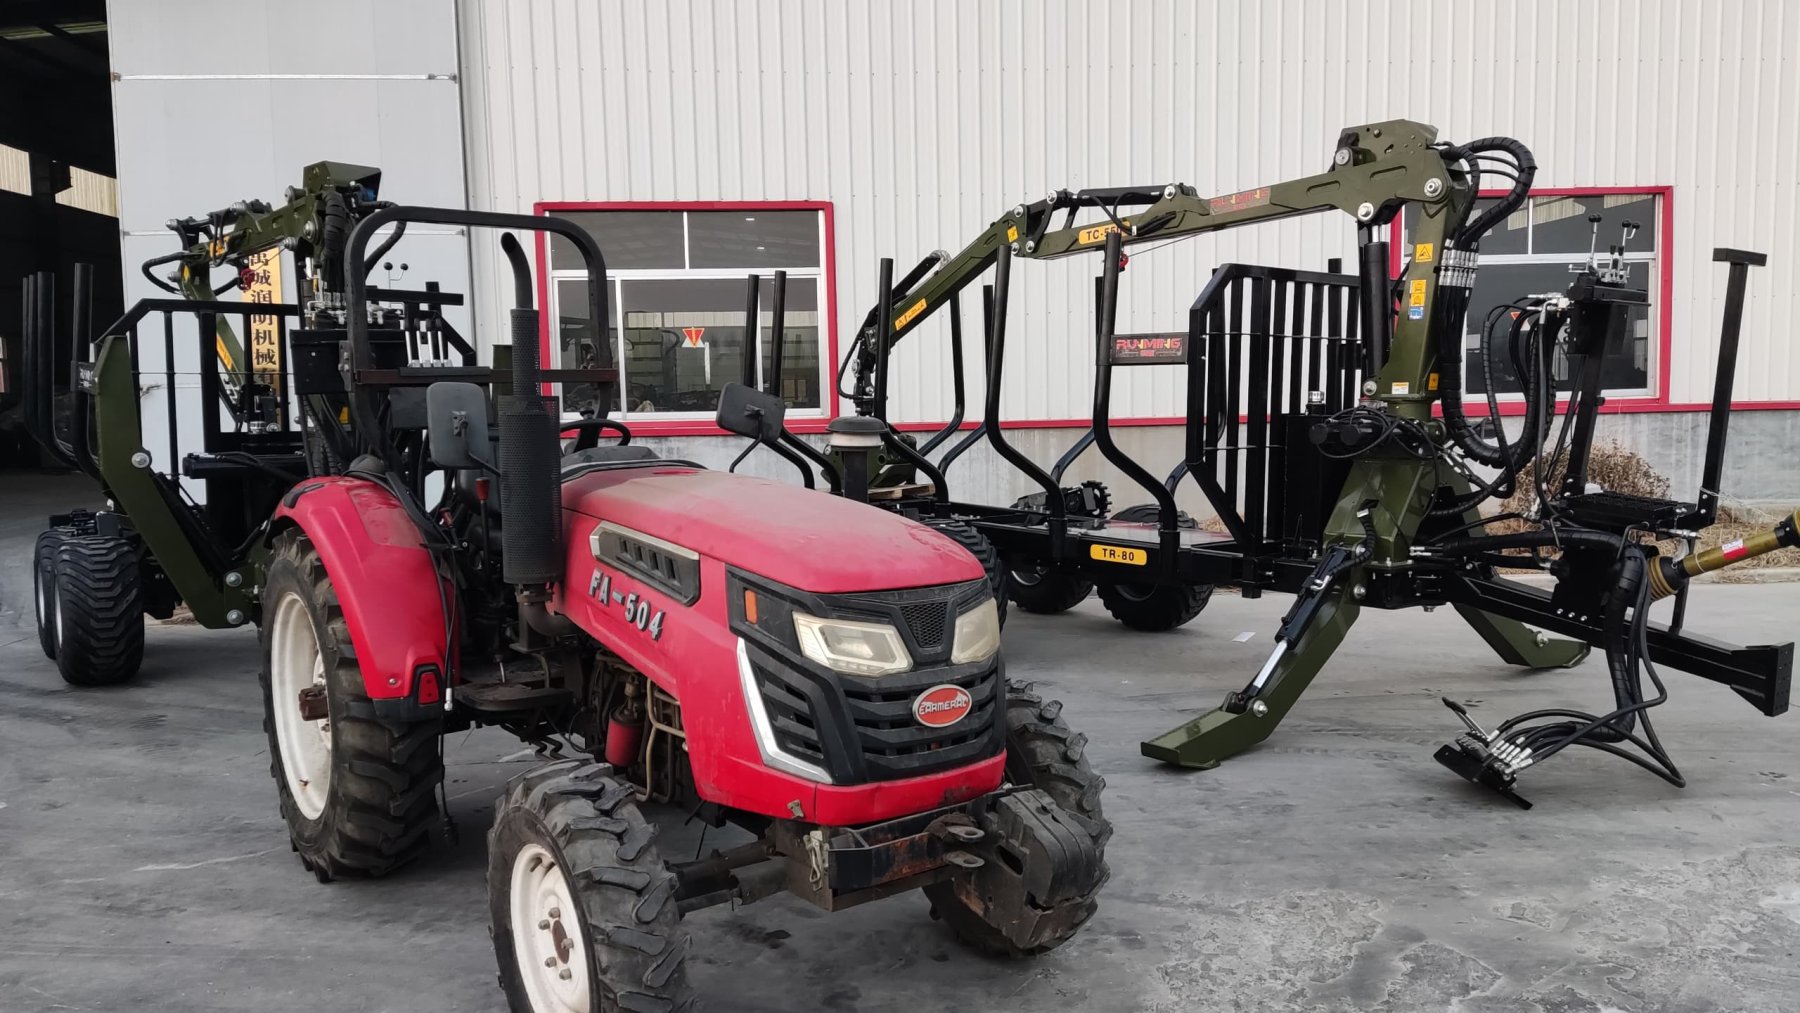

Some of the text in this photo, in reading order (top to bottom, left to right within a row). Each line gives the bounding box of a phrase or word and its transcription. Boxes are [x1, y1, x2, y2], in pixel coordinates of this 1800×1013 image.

[1116, 338, 1182, 349] RUNMING
[1102, 548, 1134, 561] TR-80
[588, 567, 665, 642] FA-504
